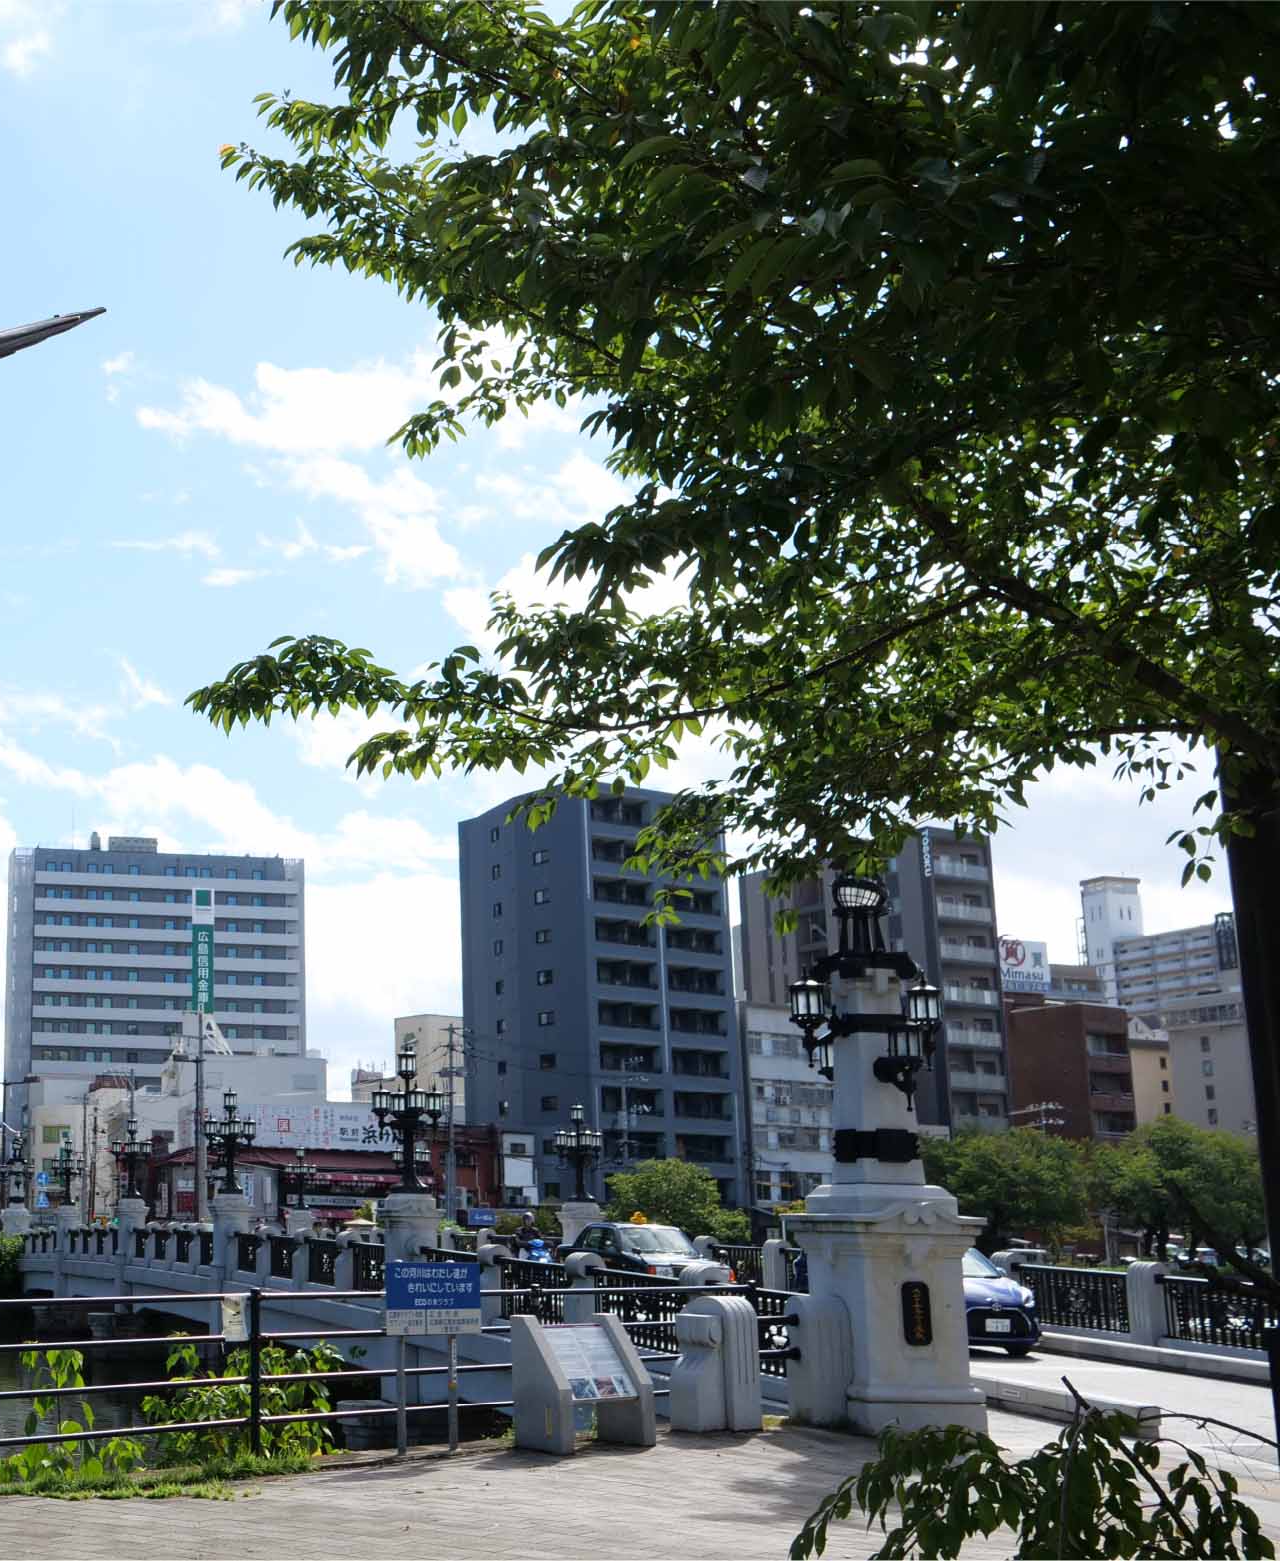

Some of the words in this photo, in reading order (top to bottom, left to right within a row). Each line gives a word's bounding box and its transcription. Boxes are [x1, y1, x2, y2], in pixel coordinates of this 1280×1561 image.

[198, 931, 209, 1003] 広島信用金庫
[407, 1282, 472, 1293] きれいにしています
